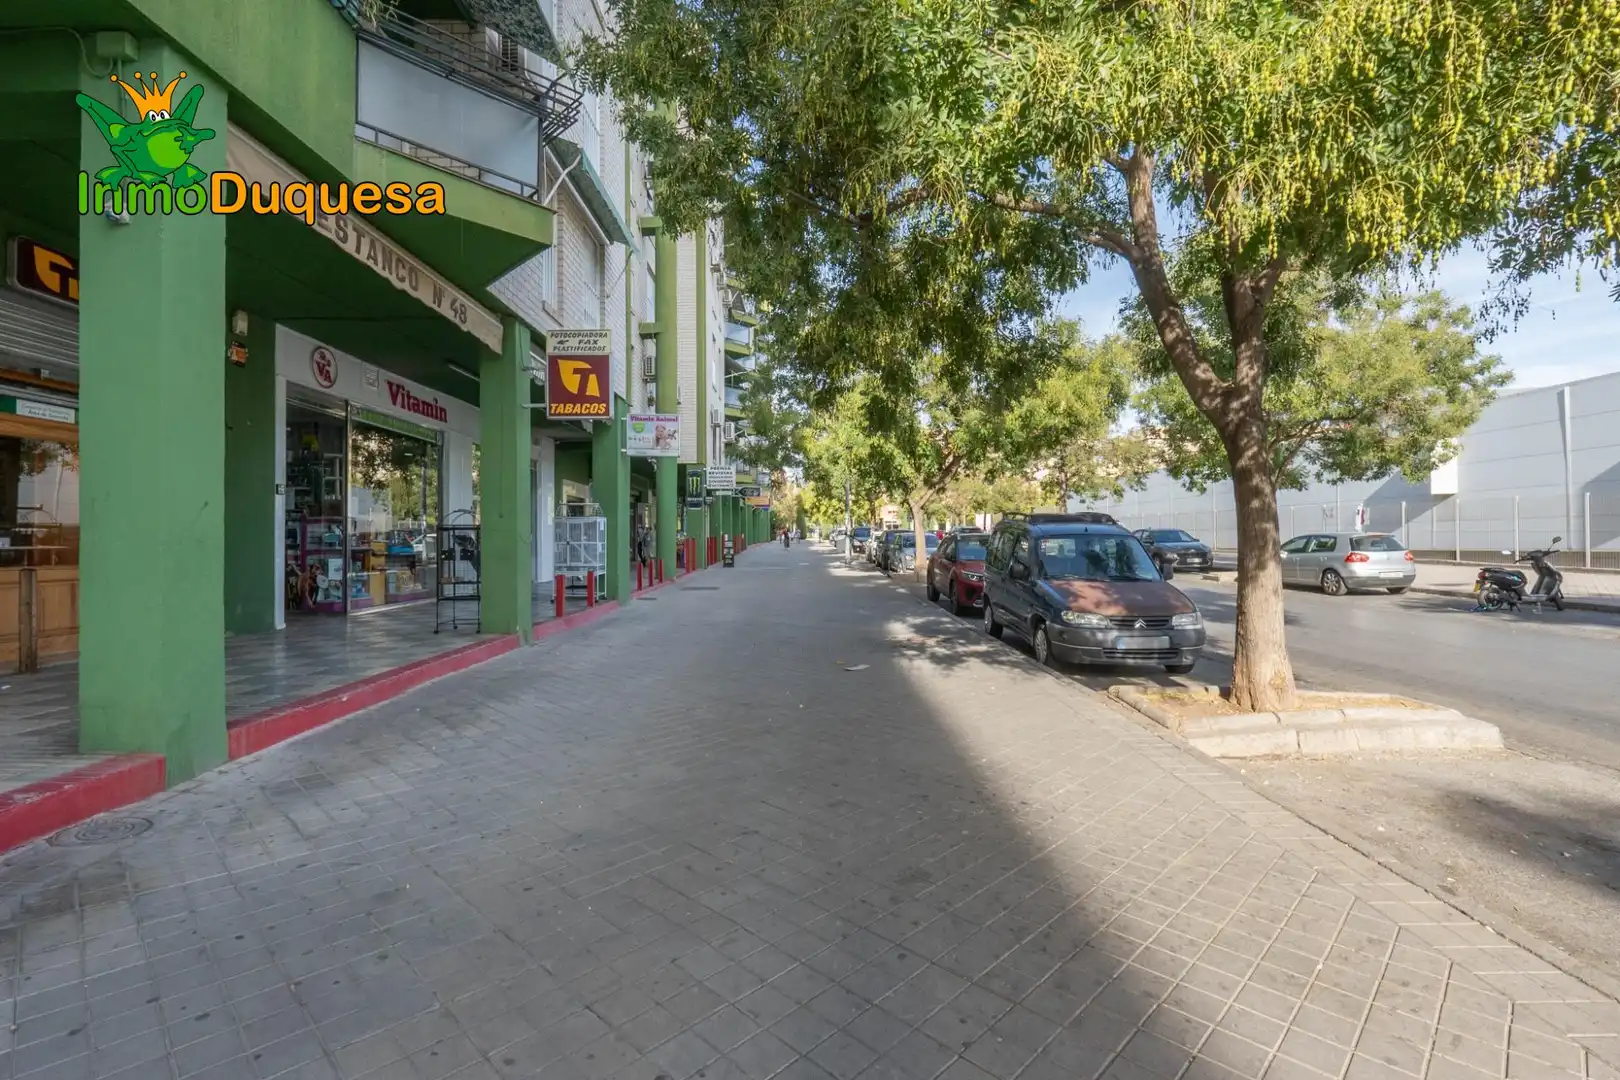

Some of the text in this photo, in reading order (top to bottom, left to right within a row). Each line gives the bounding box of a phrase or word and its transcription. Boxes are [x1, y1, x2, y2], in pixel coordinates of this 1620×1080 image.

[317, 212, 420, 293] ESTANCO
[450, 296, 468, 325] 48
[386, 379, 448, 424] Vitamin
[550, 403, 607, 414] TABACOS
